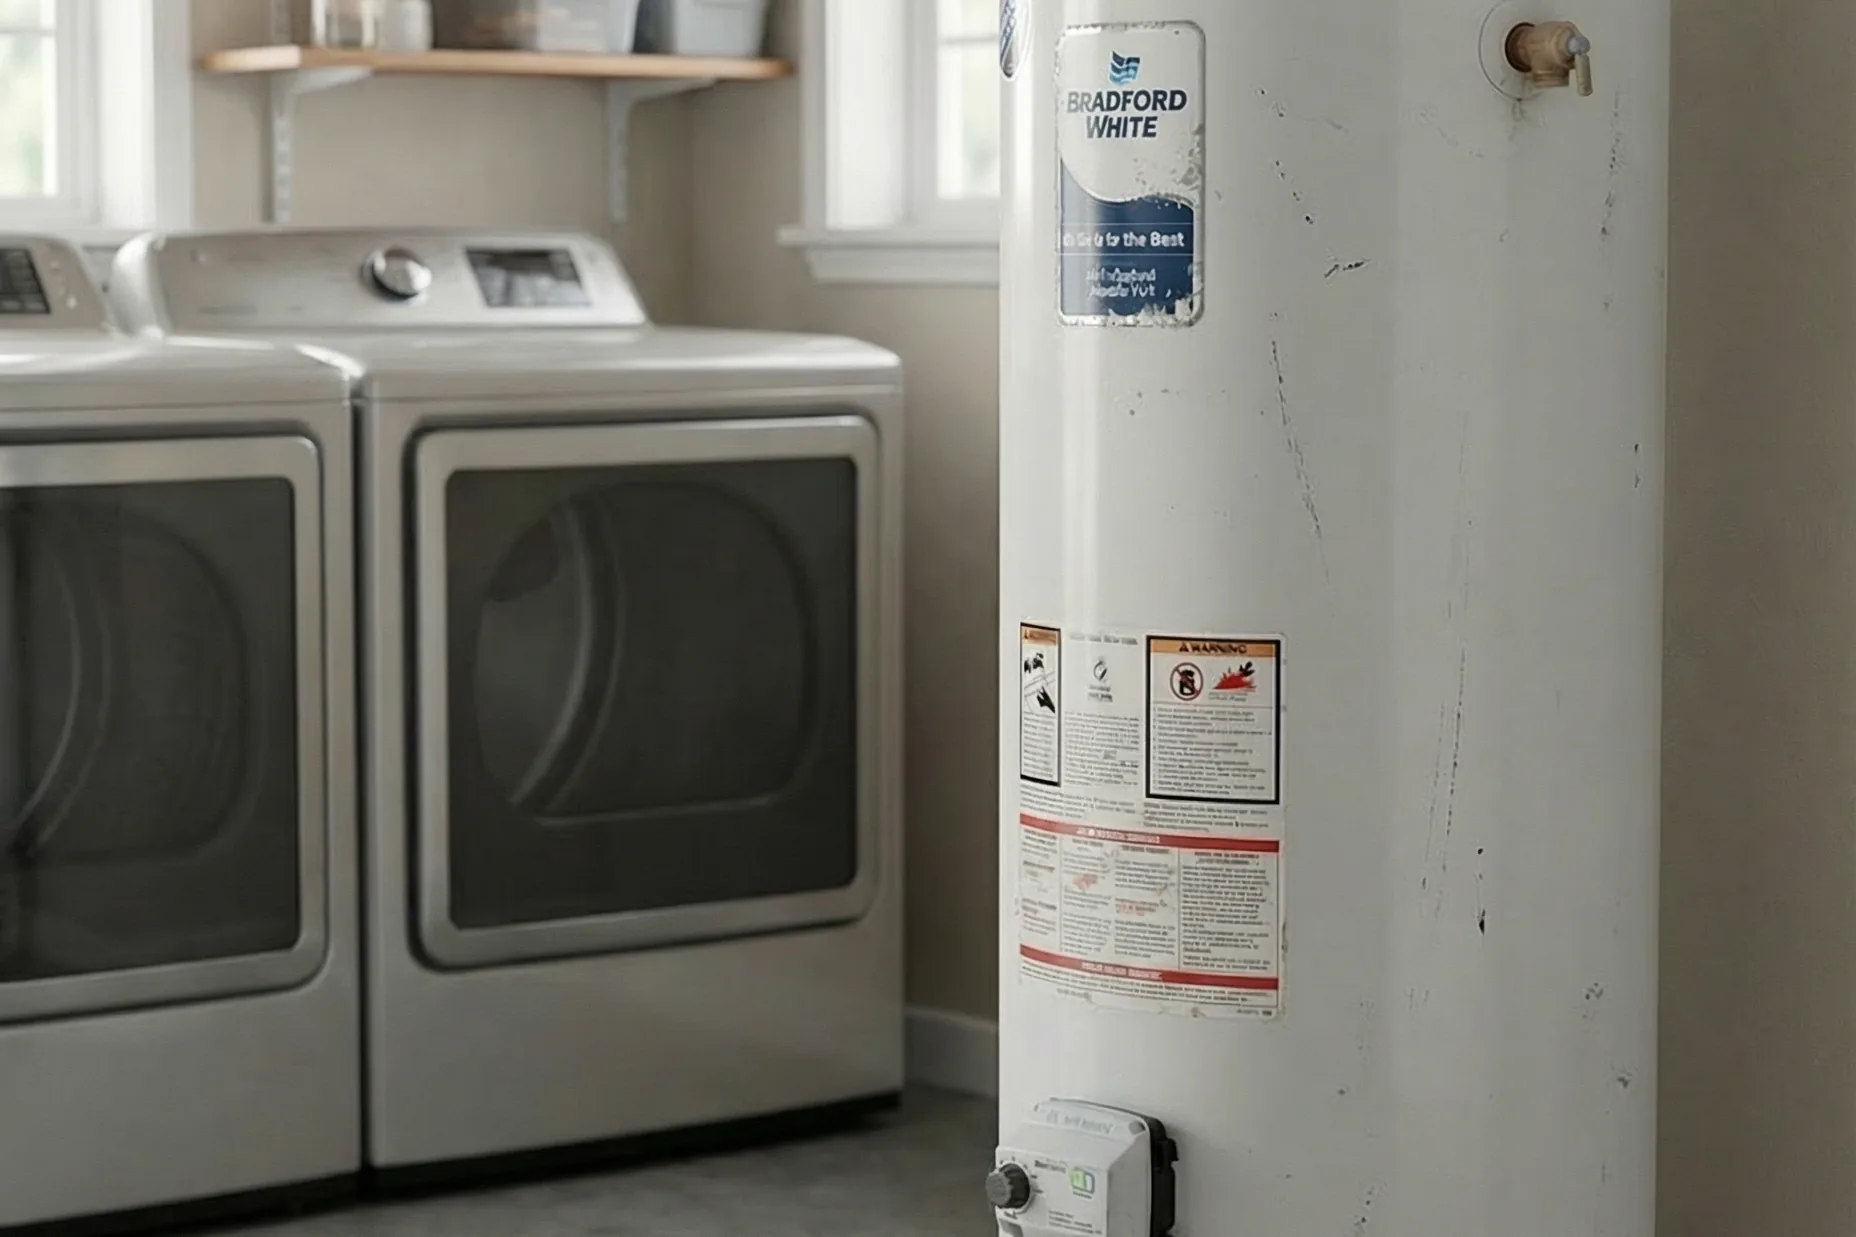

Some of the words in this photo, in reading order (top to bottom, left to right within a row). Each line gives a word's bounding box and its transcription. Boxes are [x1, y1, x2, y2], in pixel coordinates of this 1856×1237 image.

[1067, 89, 1188, 113] BRADFORD
[1086, 115, 1158, 139] WHITE
[1123, 231, 1147, 247] the
[1150, 231, 1185, 247] Best
